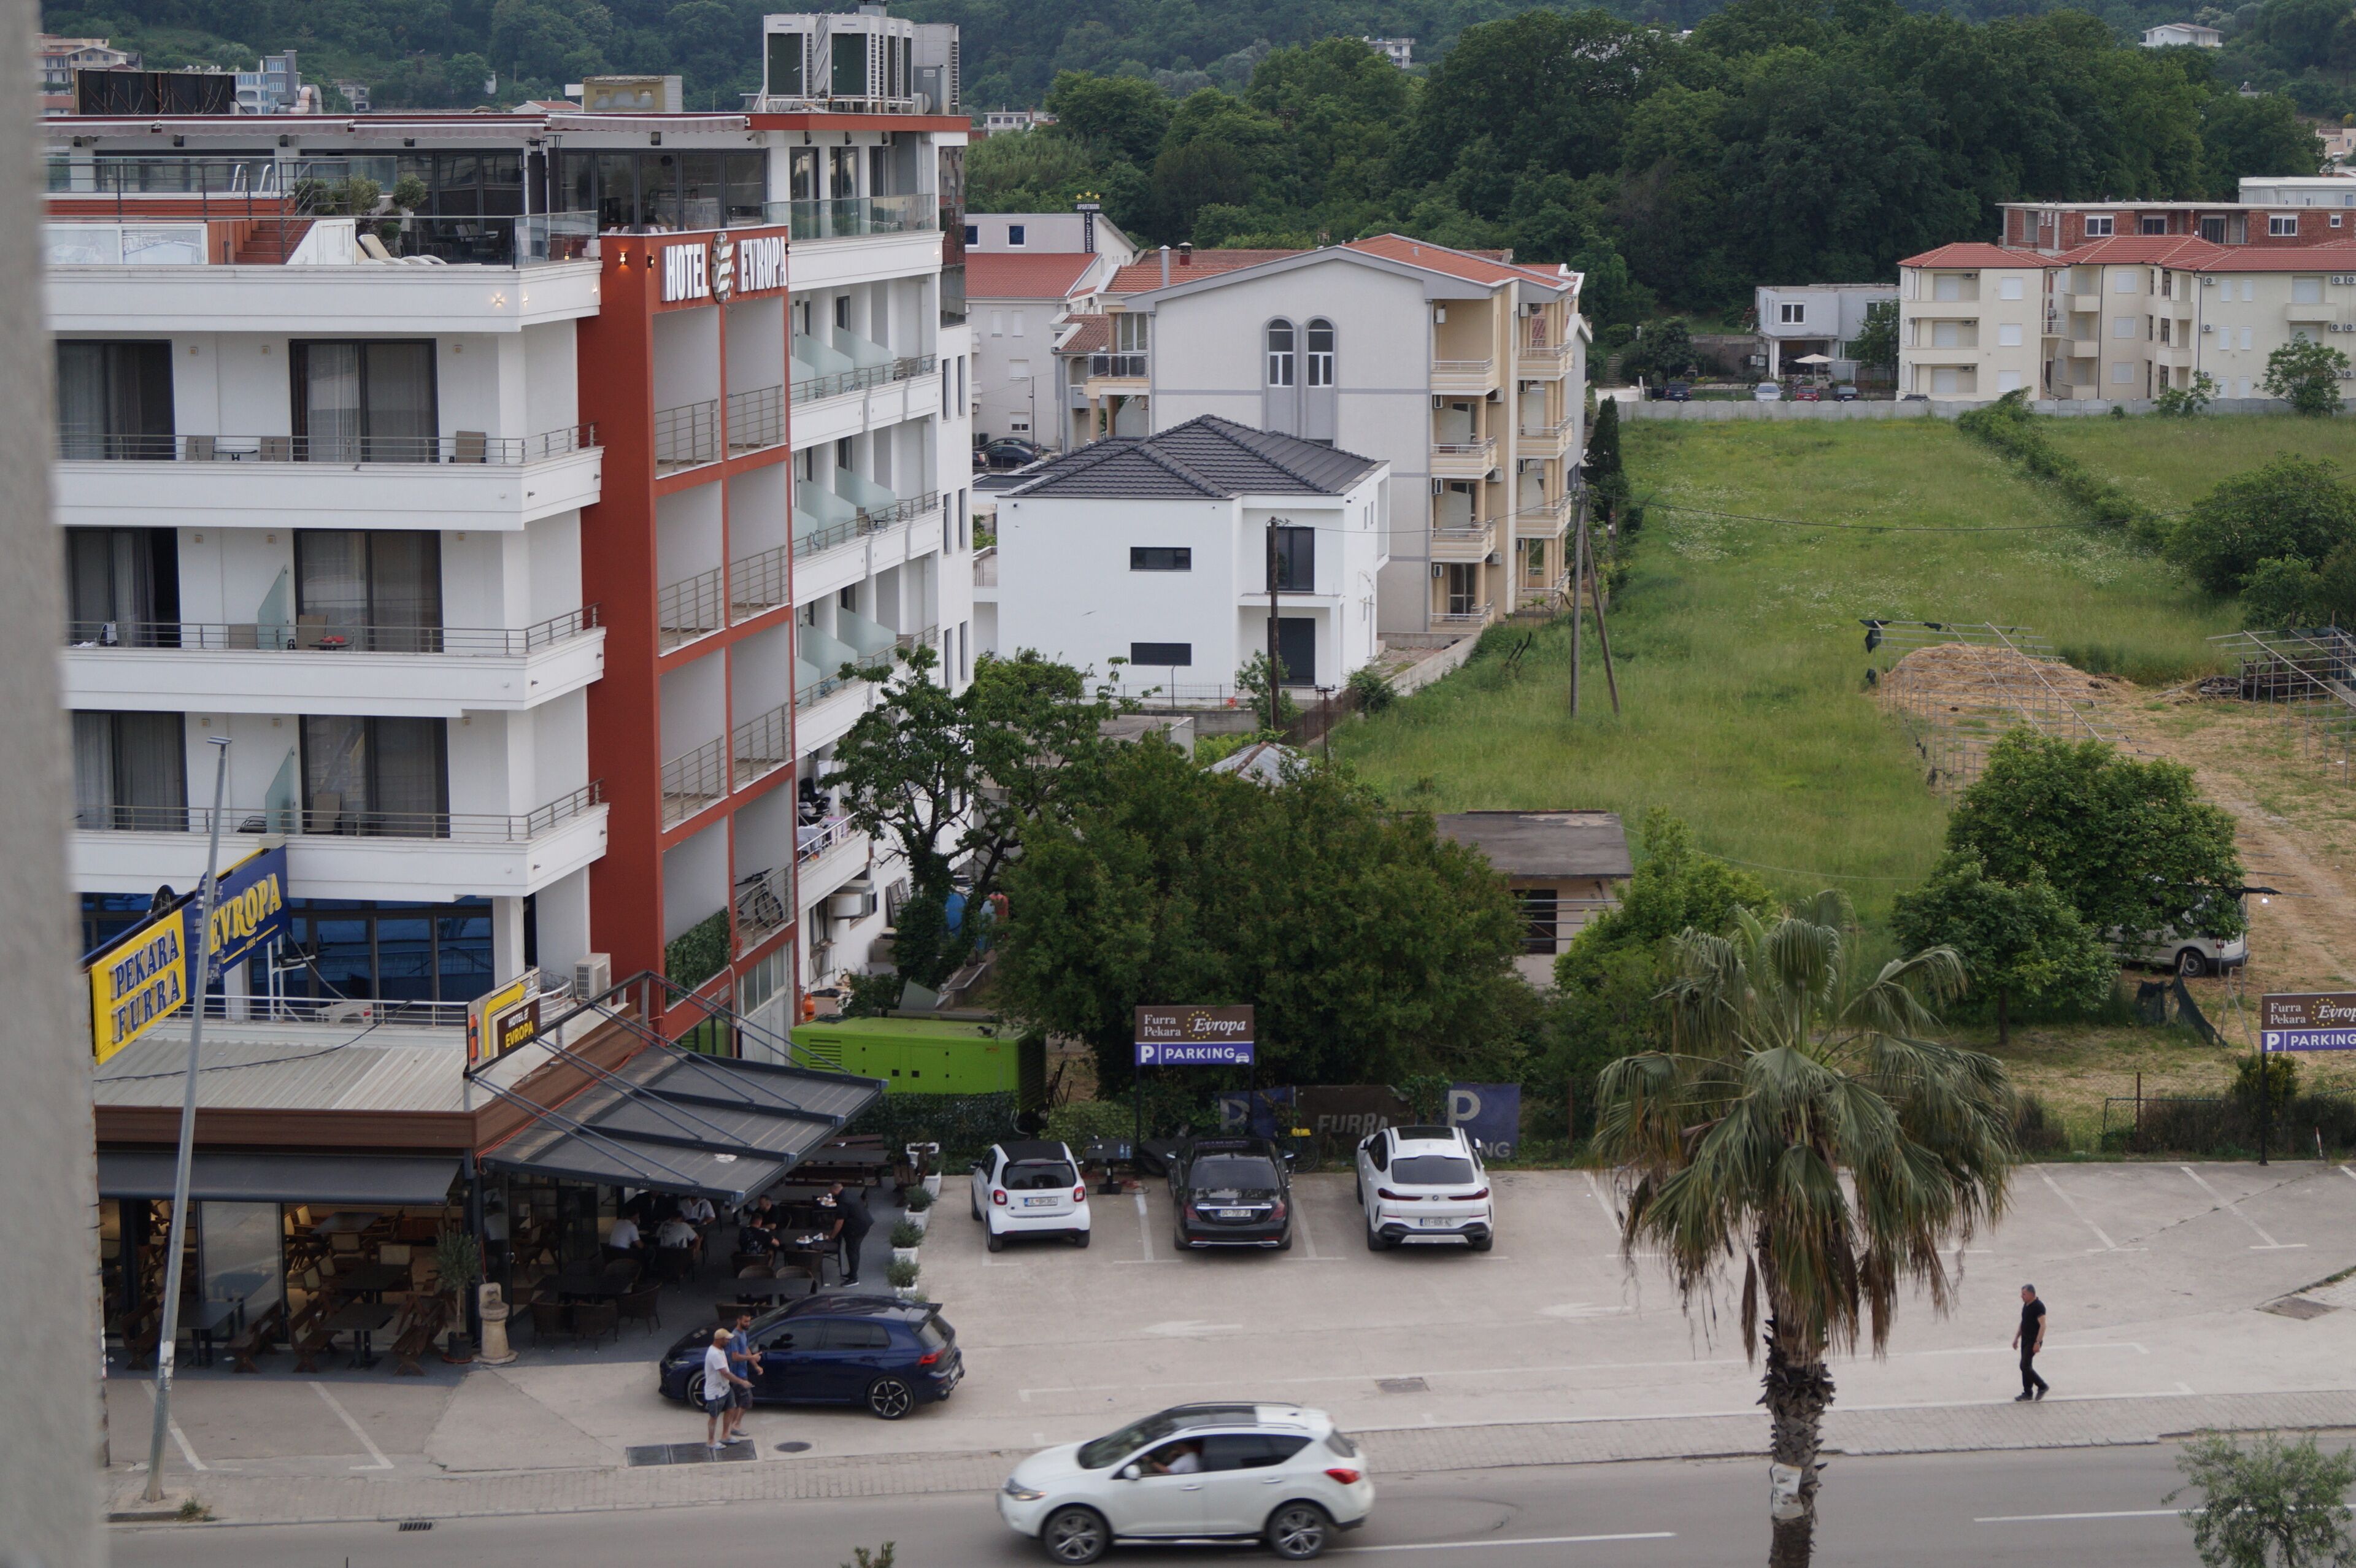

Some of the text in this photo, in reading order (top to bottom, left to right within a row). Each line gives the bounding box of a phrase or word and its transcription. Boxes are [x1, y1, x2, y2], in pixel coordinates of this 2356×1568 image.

[665, 236, 787, 301] HOTEL EVROPA
[210, 873, 282, 955] EVROPA
[114, 929, 179, 999] PEKARA
[117, 970, 180, 1042] FURRA
[2270, 1002, 2301, 1013] Furra
[508, 1012, 524, 1028] HOTEL
[1144, 1014, 1176, 1024] Furra
[1192, 1018, 1246, 1036] Evropa
[2270, 1014, 2306, 1024] Pekara
[506, 1020, 534, 1048] EVROPA
[1144, 1026, 1182, 1037] Pekara
[2266, 1033, 2356, 1050] P PARKING
[1141, 1045, 1235, 1063] P PARKING
[1317, 1113, 1388, 1137] FURRA
